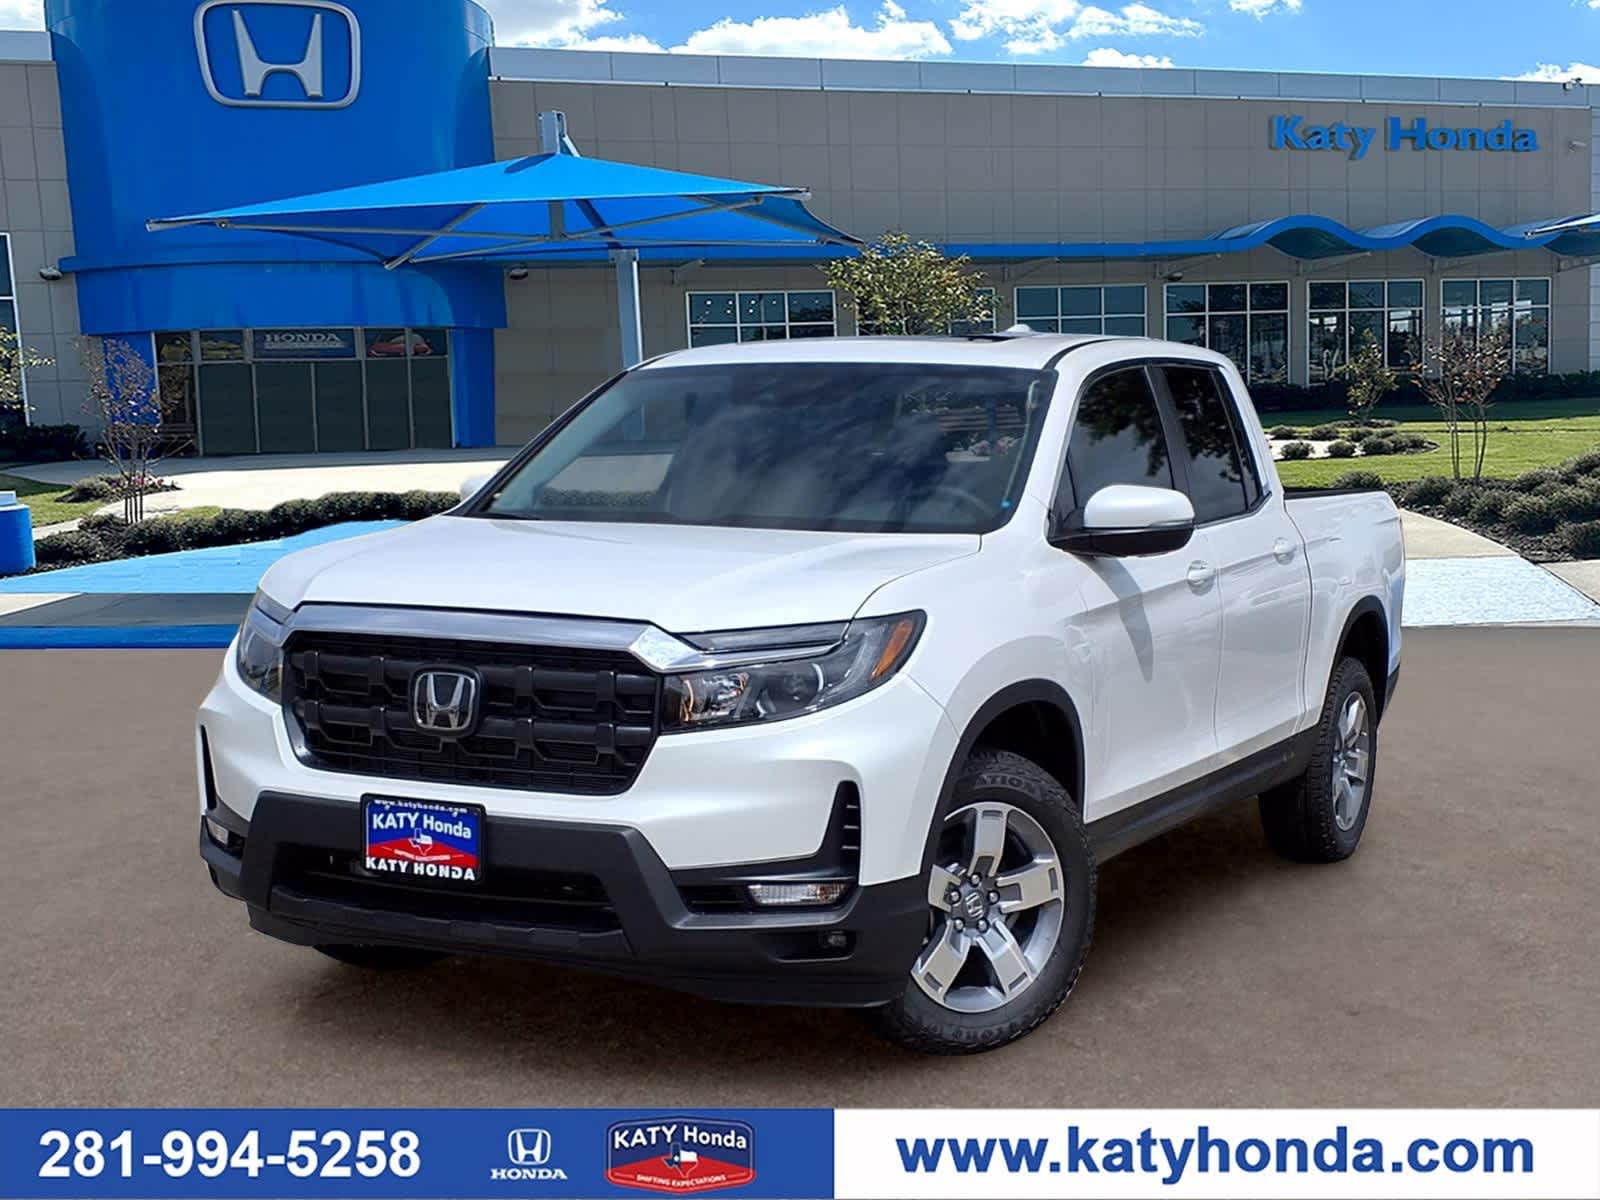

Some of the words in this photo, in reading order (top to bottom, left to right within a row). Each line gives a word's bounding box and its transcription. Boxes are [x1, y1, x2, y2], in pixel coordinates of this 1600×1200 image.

[1271, 115, 1376, 160] Katy
[1386, 116, 1540, 152] Honda
[264, 332, 341, 342] HONDA
[373, 812, 419, 829] KATY
[423, 814, 471, 839] Honda
[366, 857, 408, 873] KATY
[413, 862, 475, 880] HONDA
